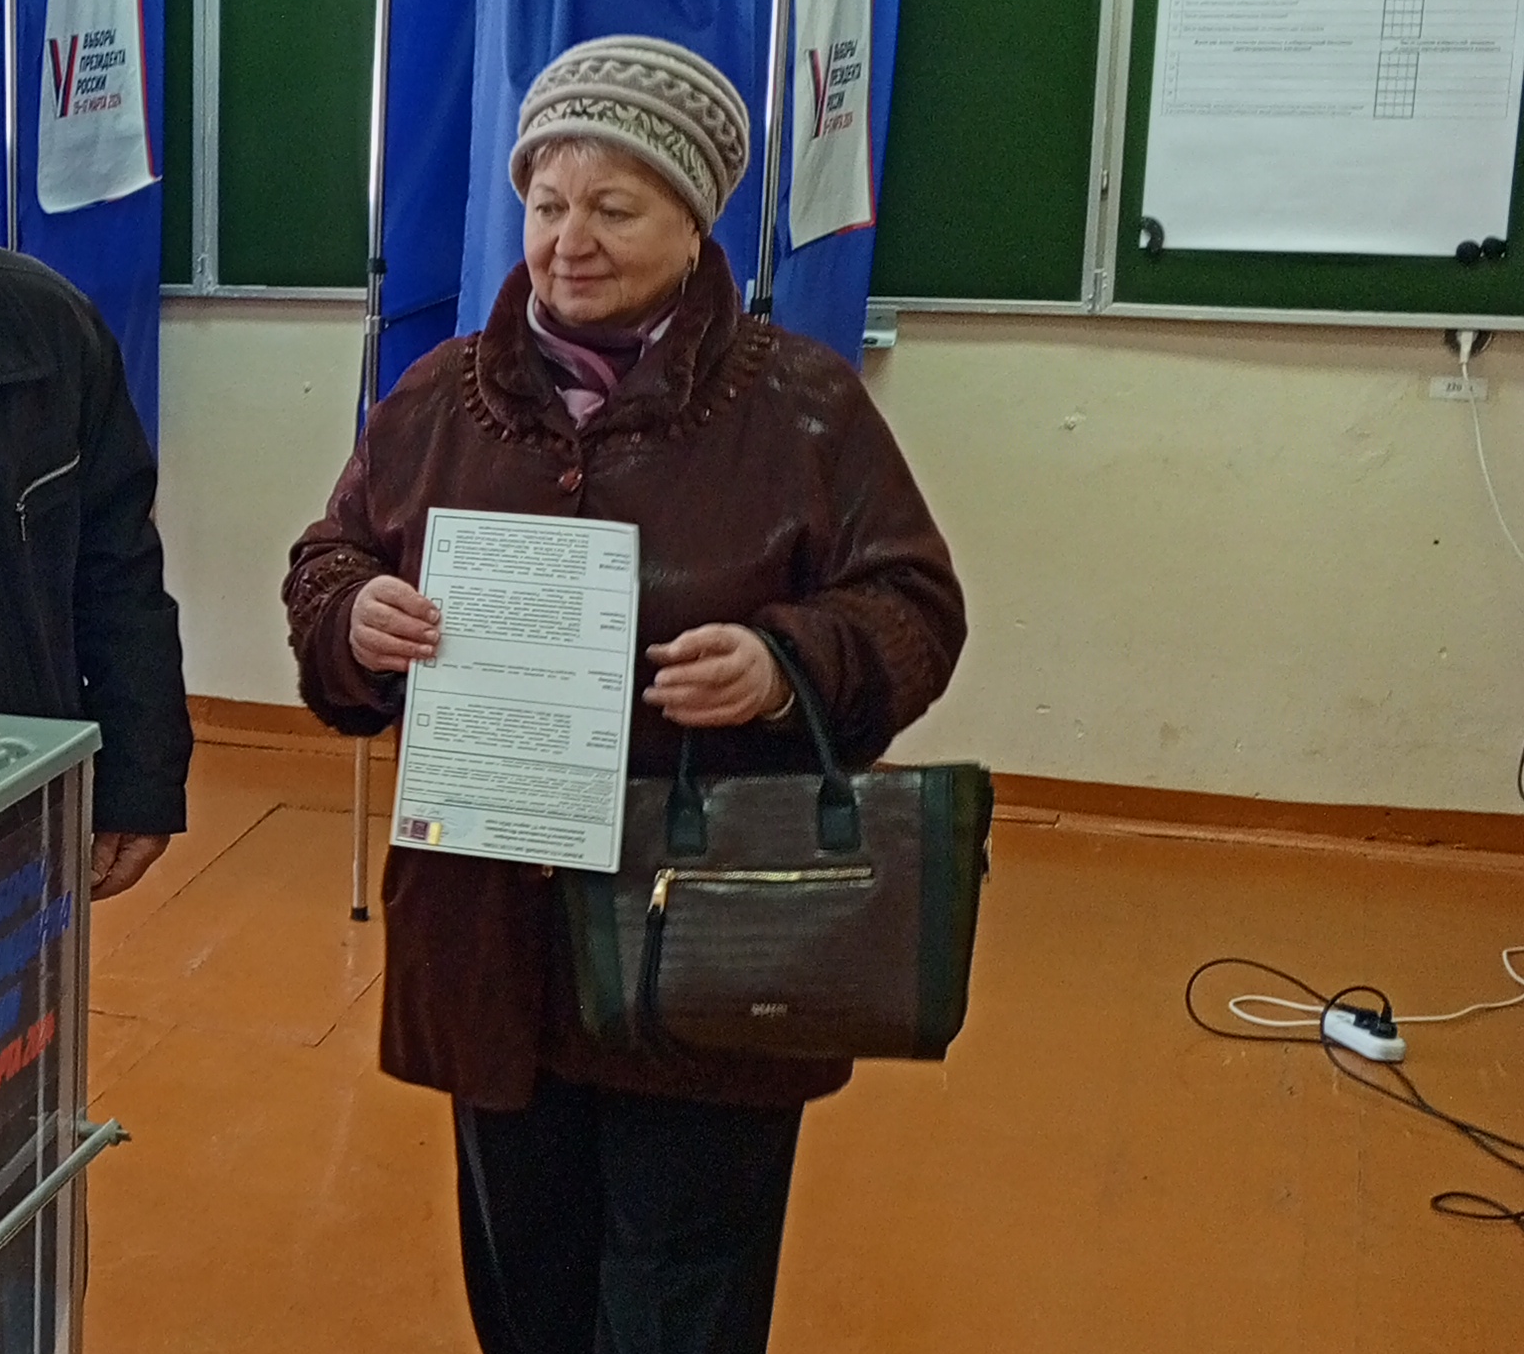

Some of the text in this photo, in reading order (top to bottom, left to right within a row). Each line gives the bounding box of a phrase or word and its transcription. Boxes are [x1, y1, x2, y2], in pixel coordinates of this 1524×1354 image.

[83, 28, 116, 49] ВЫБОРЫ
[79, 49, 126, 73] ПРЕЗИДЕНТА
[75, 74, 107, 96] РОССИИ
